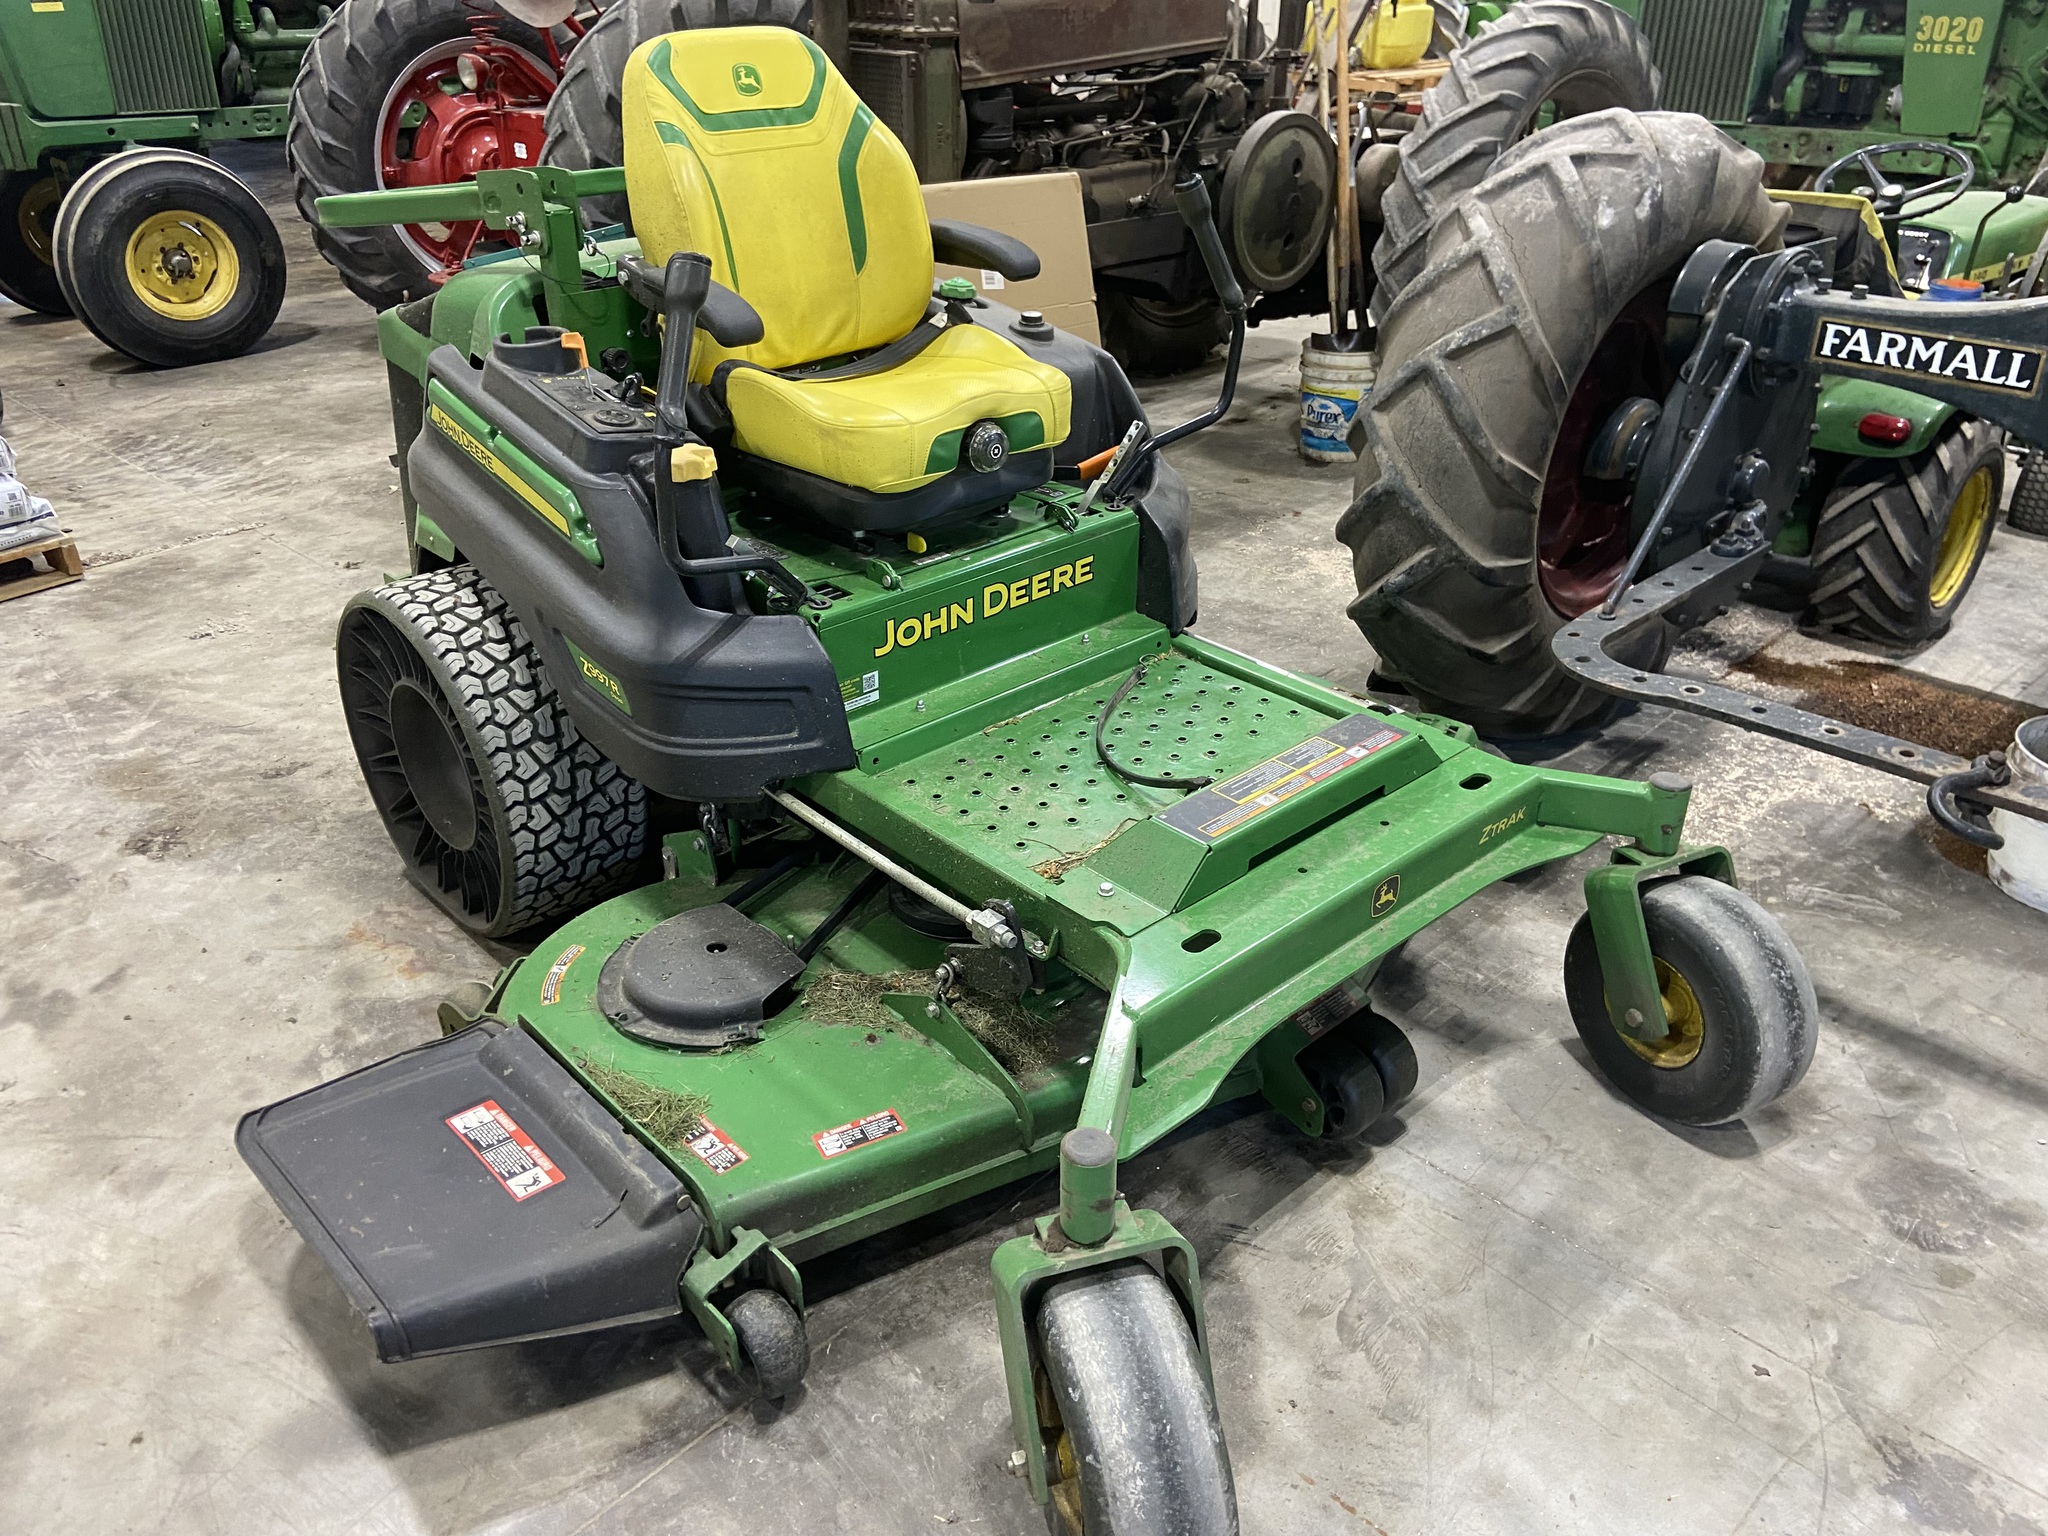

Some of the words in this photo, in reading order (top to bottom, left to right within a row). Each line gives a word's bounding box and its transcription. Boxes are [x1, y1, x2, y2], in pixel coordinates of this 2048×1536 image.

[1913, 43, 1976, 55] DIESEL
[1916, 15, 1984, 43] 3020
[1820, 322, 2031, 389] FARMALL
[437, 410, 462, 444] JOHN
[461, 431, 494, 472] DEERE
[874, 597, 974, 658] JOHN
[983, 555, 1094, 619] DEERE
[1479, 806, 1526, 845] ZTRAK
